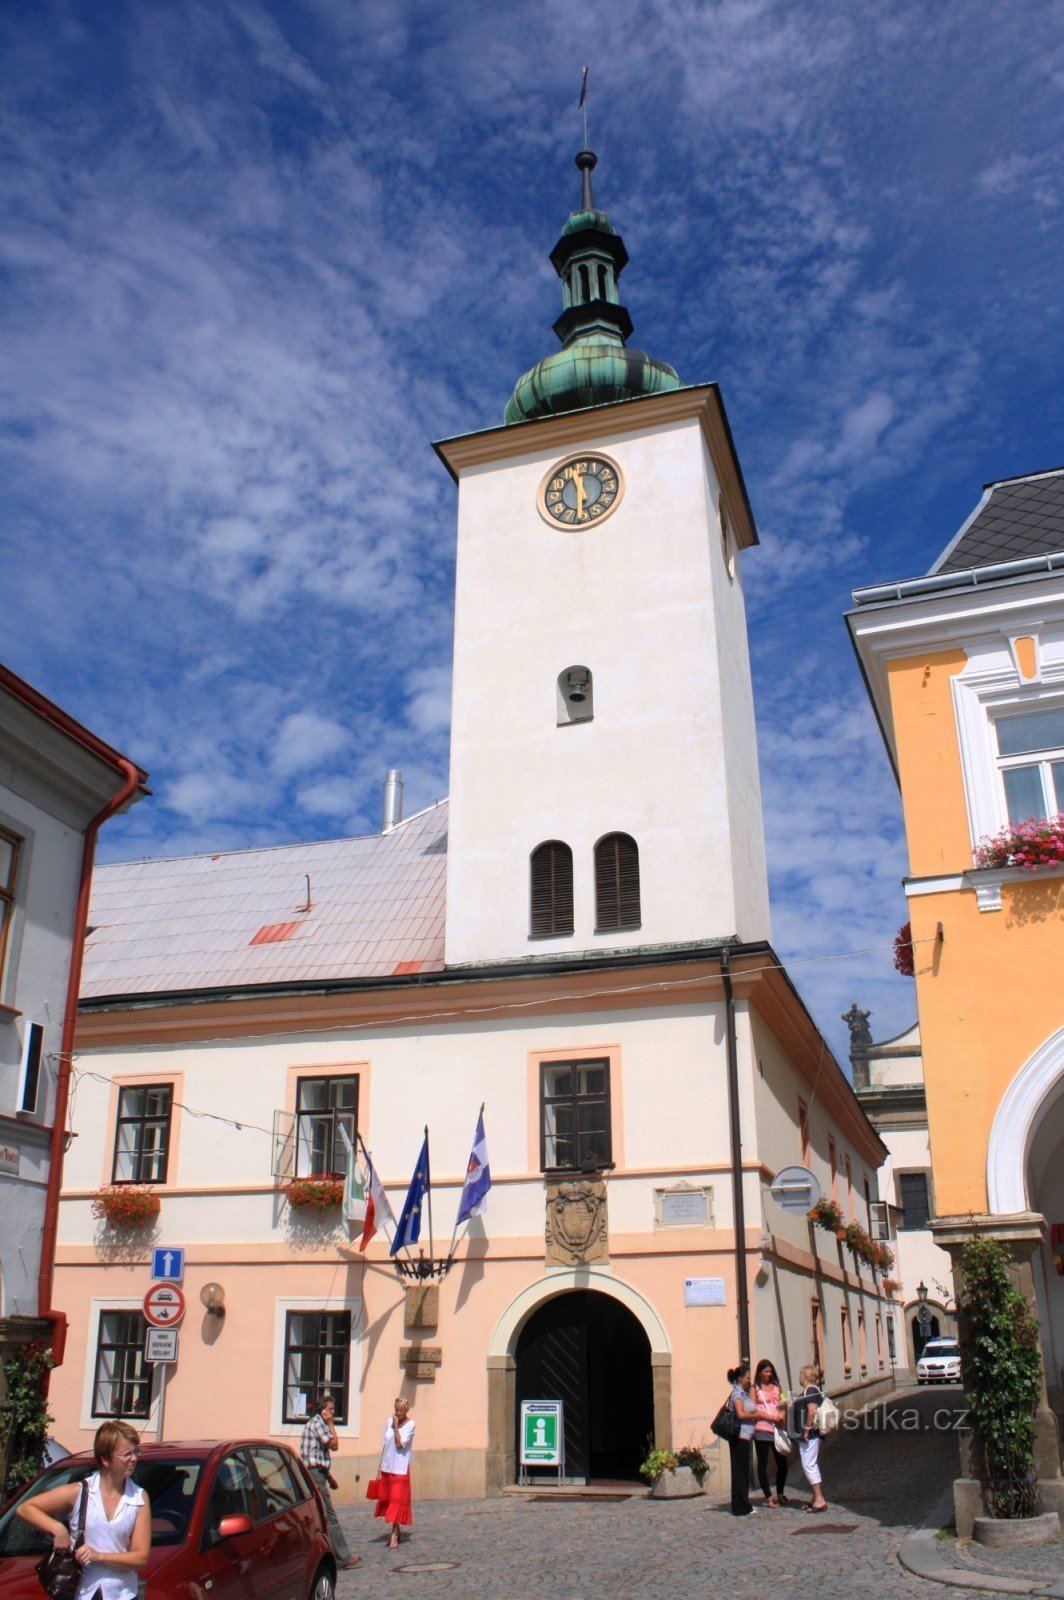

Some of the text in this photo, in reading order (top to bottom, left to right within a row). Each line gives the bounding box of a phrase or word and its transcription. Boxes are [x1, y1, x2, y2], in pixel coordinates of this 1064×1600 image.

[564, 467, 573, 479] 11
[576, 462, 587, 474] 12
[601, 468, 611, 480] 2
[552, 479, 564, 491] 10
[605, 480, 615, 491] 3
[550, 492, 559, 503] 9
[601, 493, 611, 504] 4
[554, 503, 563, 514] 8
[592, 504, 600, 516] 5
[565, 509, 574, 521] 7
